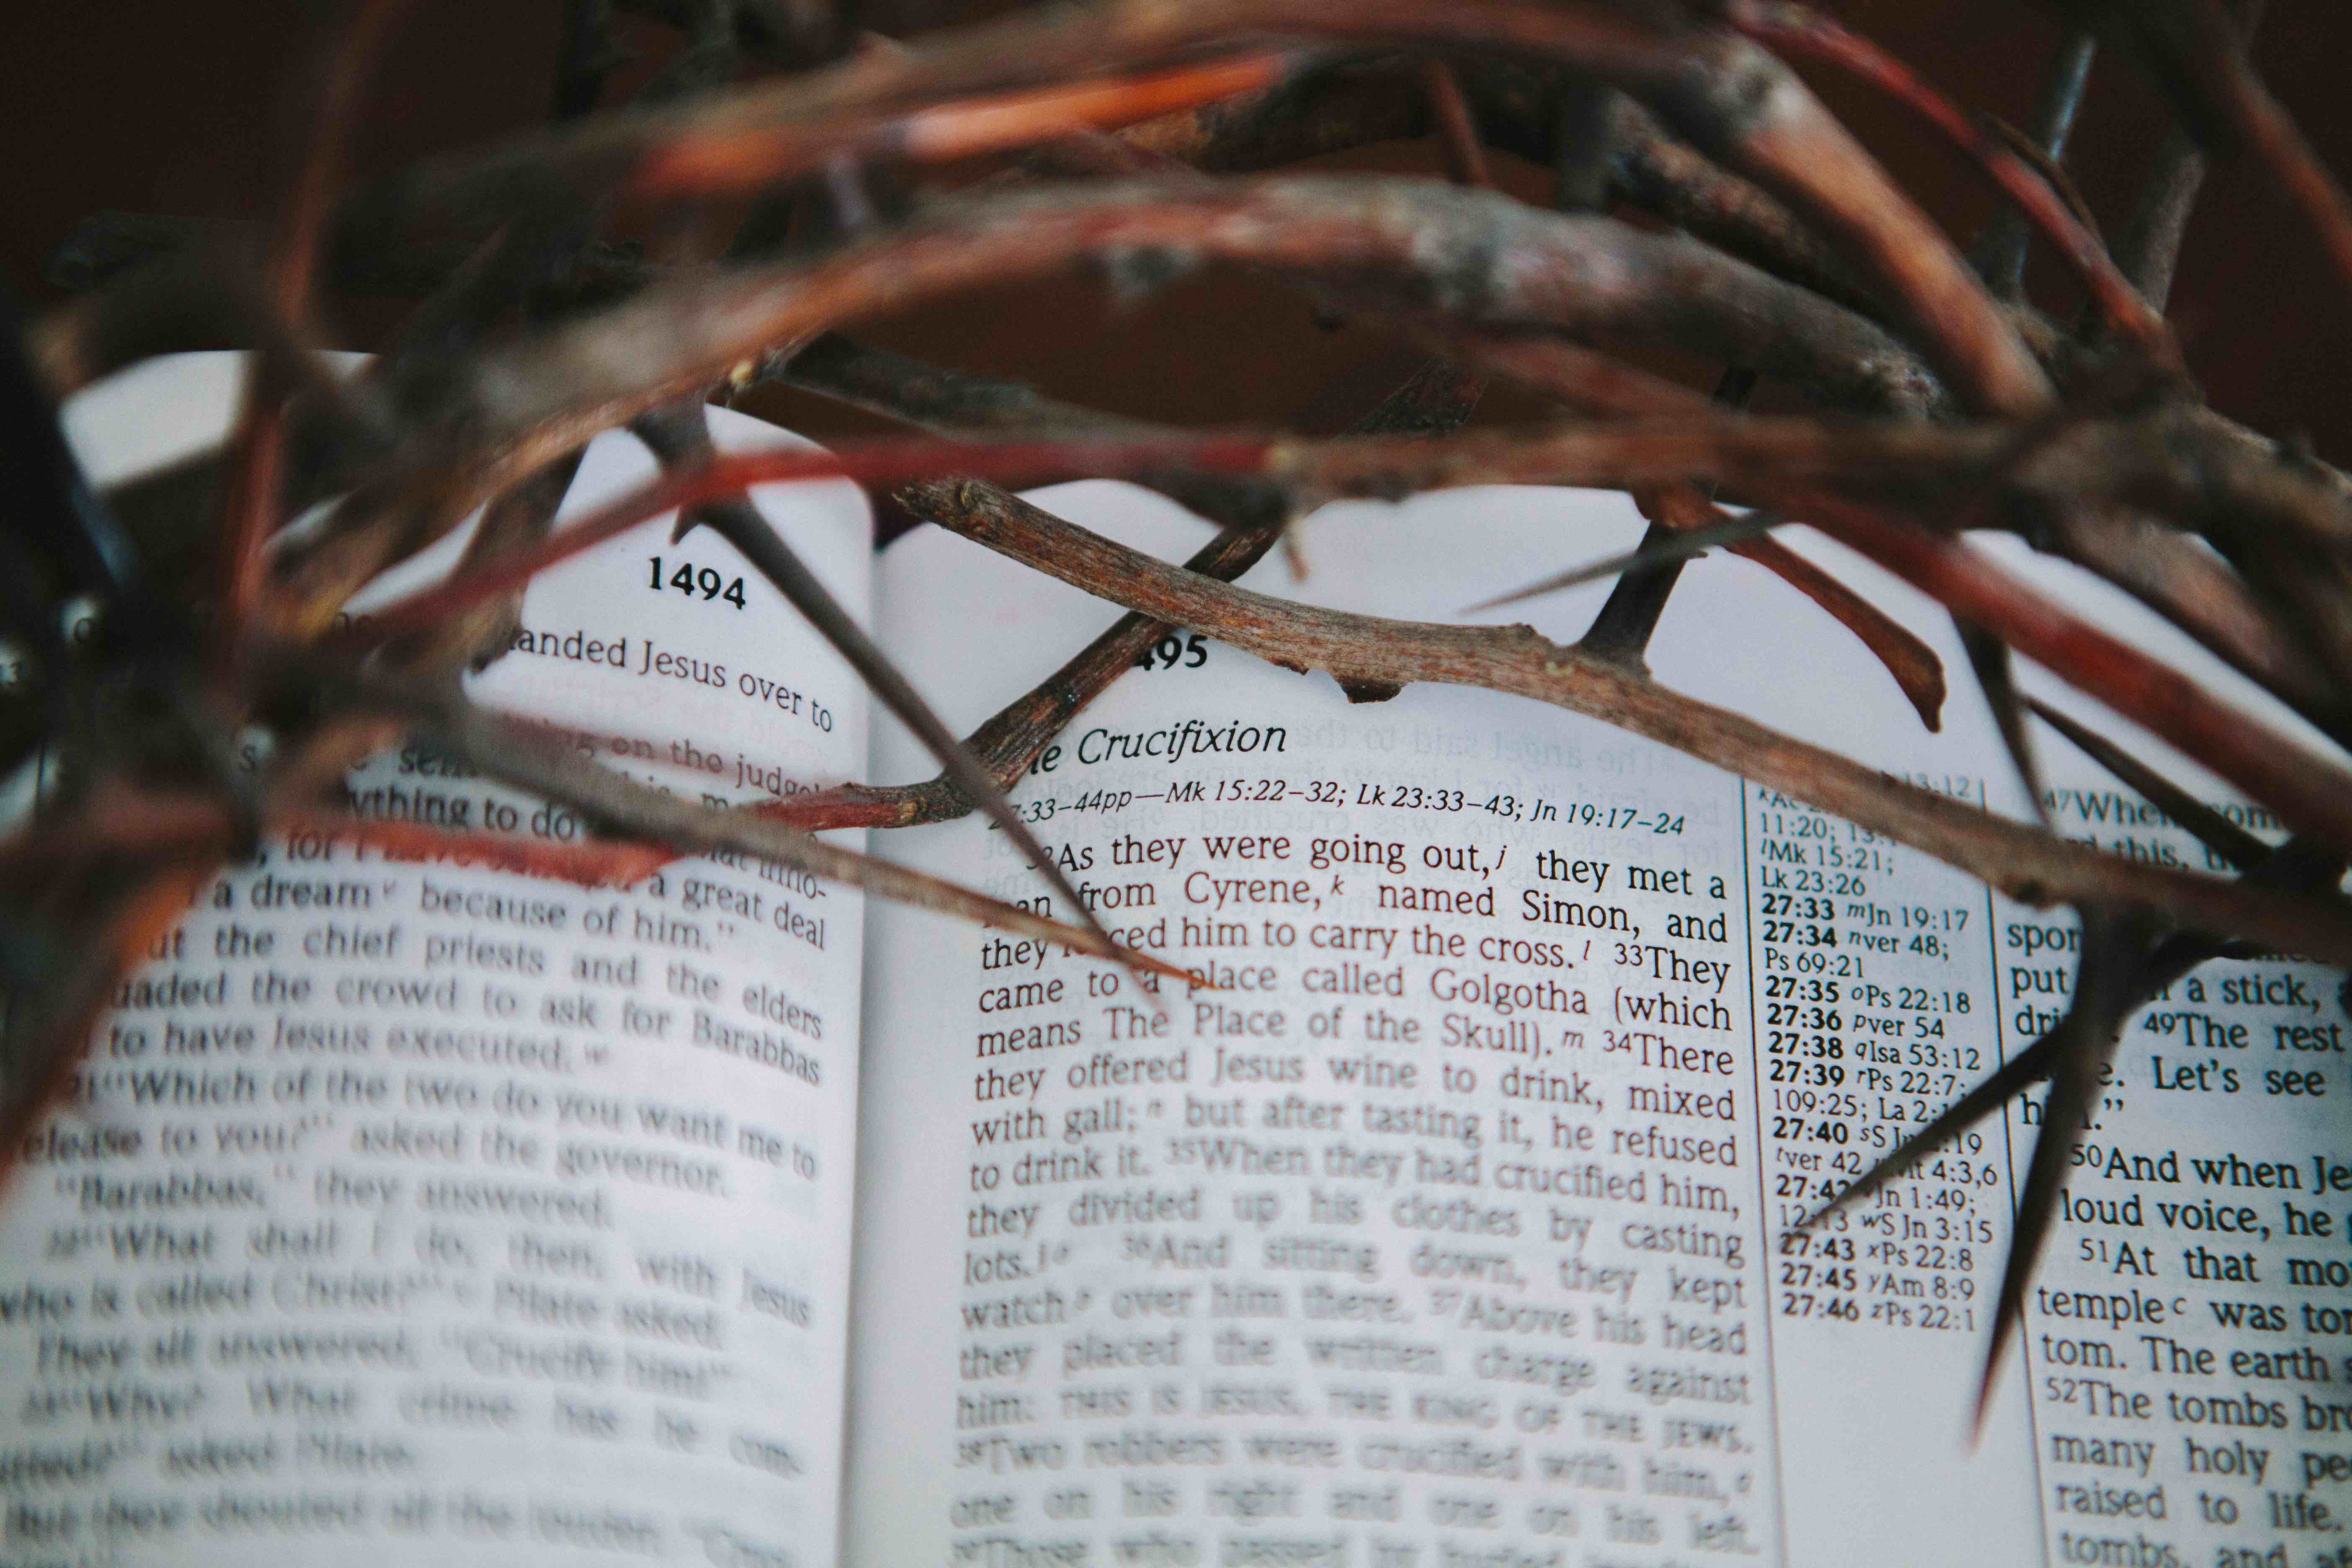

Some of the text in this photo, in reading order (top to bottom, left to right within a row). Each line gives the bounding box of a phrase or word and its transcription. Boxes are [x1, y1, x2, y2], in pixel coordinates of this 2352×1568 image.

[649, 557, 746, 609] 1494
[512, 629, 832, 733] anded Jesus over to
[1077, 719, 1288, 765] Crucifixion
[486, 798, 574, 839] to do
[1214, 778, 1686, 836] 15:22–32; Lk 23:33–43; Jn 19:17–24
[1761, 812, 1837, 850] 11:20;
[1111, 834, 1186, 870] they
[1203, 836, 1291, 861] were
[1310, 833, 1406, 874] going
[1536, 848, 1610, 893] they
[1628, 864, 1693, 897] met
[1709, 874, 1728, 900] a
[1760, 864, 1867, 898] Lk 23:26
[1818, 845, 1895, 877] 15:21;
[212, 877, 234, 910] a
[250, 875, 371, 909] dream
[421, 879, 567, 926] because
[583, 905, 619, 937] of
[648, 871, 825, 951] a great deal
[1078, 881, 1156, 913] from
[1379, 883, 1494, 919] named
[1522, 890, 1642, 940] Simon,
[1666, 910, 1729, 944] and
[1761, 892, 1836, 922] 27:33
[1901, 905, 1970, 933] 19:17
[981, 937, 1049, 972] they
[1180, 916, 1249, 948] him
[1263, 921, 1296, 948] to
[1310, 921, 1398, 960] carry
[1412, 922, 1466, 958] the
[1762, 919, 1839, 949] 27:34
[1908, 934, 1950, 963] 48;
[1764, 946, 1865, 979] Ps 69:21
[424, 931, 545, 975] priests
[571, 956, 638, 988] and
[667, 962, 719, 1003] the
[741, 984, 822, 1041] elders
[978, 959, 1734, 1032] came to a place called Golgotha (which
[1765, 974, 1841, 1004] 27:35
[1898, 987, 1972, 1016] 22:18
[2009, 963, 2069, 1000] put
[2187, 977, 2206, 1003] a
[2222, 972, 2321, 1014] stick,
[976, 1019, 1082, 1058] means
[1102, 1006, 1171, 1042] The
[1193, 1002, 1285, 1038] Place
[1306, 1005, 1344, 1038] of
[1365, 1008, 1421, 1043] the
[1766, 1002, 1843, 1032] 27:36
[1914, 1015, 1945, 1040] 54
[2274, 1021, 2347, 1053] rest
[690, 1008, 820, 1087] Barabbas
[1768, 1030, 1844, 1060] 27:38
[1908, 1045, 1981, 1072] 53:12
[975, 1047, 1736, 1122] they offered Jesus wine to drink, mixed
[1769, 1058, 1845, 1088] 27:39
[2151, 1054, 2327, 1097] Let's see
[1773, 1088, 1906, 1122] 109:25; La
[971, 1095, 1739, 1168] with after tasting he refused
[1772, 1115, 1849, 1145] 27:40
[970, 1145, 1741, 1222] to drink crucified him,
[1831, 1151, 1862, 1176] 42
[1932, 1159, 1999, 1189] 4:3,6
[2190, 1153, 2303, 1190] when
[2313, 1155, 2352, 1196] Je
[1911, 1186, 1977, 1217] 1:49;
[2061, 1188, 2334, 1243] loud voice, he
[1622, 1220, 1746, 1271] casting
[1902, 1213, 1929, 1242] Jn
[1936, 1216, 1994, 1246] 3:15
[1780, 1232, 1855, 1262] 27:43
[1915, 1245, 1975, 1273] 22:8
[2183, 1246, 2263, 1283] that
[2288, 1256, 2352, 1287] mo
[1667, 1266, 1748, 1314] kept
[1781, 1262, 1858, 1292] 27:45
[1934, 1274, 1976, 1300] 8:9
[1782, 1292, 1861, 1323] 27:46
[1919, 1304, 1976, 1333] 22:1
[2209, 1300, 2288, 1332] was
[1662, 1313, 1748, 1357] head
[2042, 1333, 2334, 1384] tom. The earth
[2168, 1390, 2290, 1431] tombs
[2051, 1432, 2272, 1486] many holy
[2056, 1482, 2345, 1532] raised to life.
